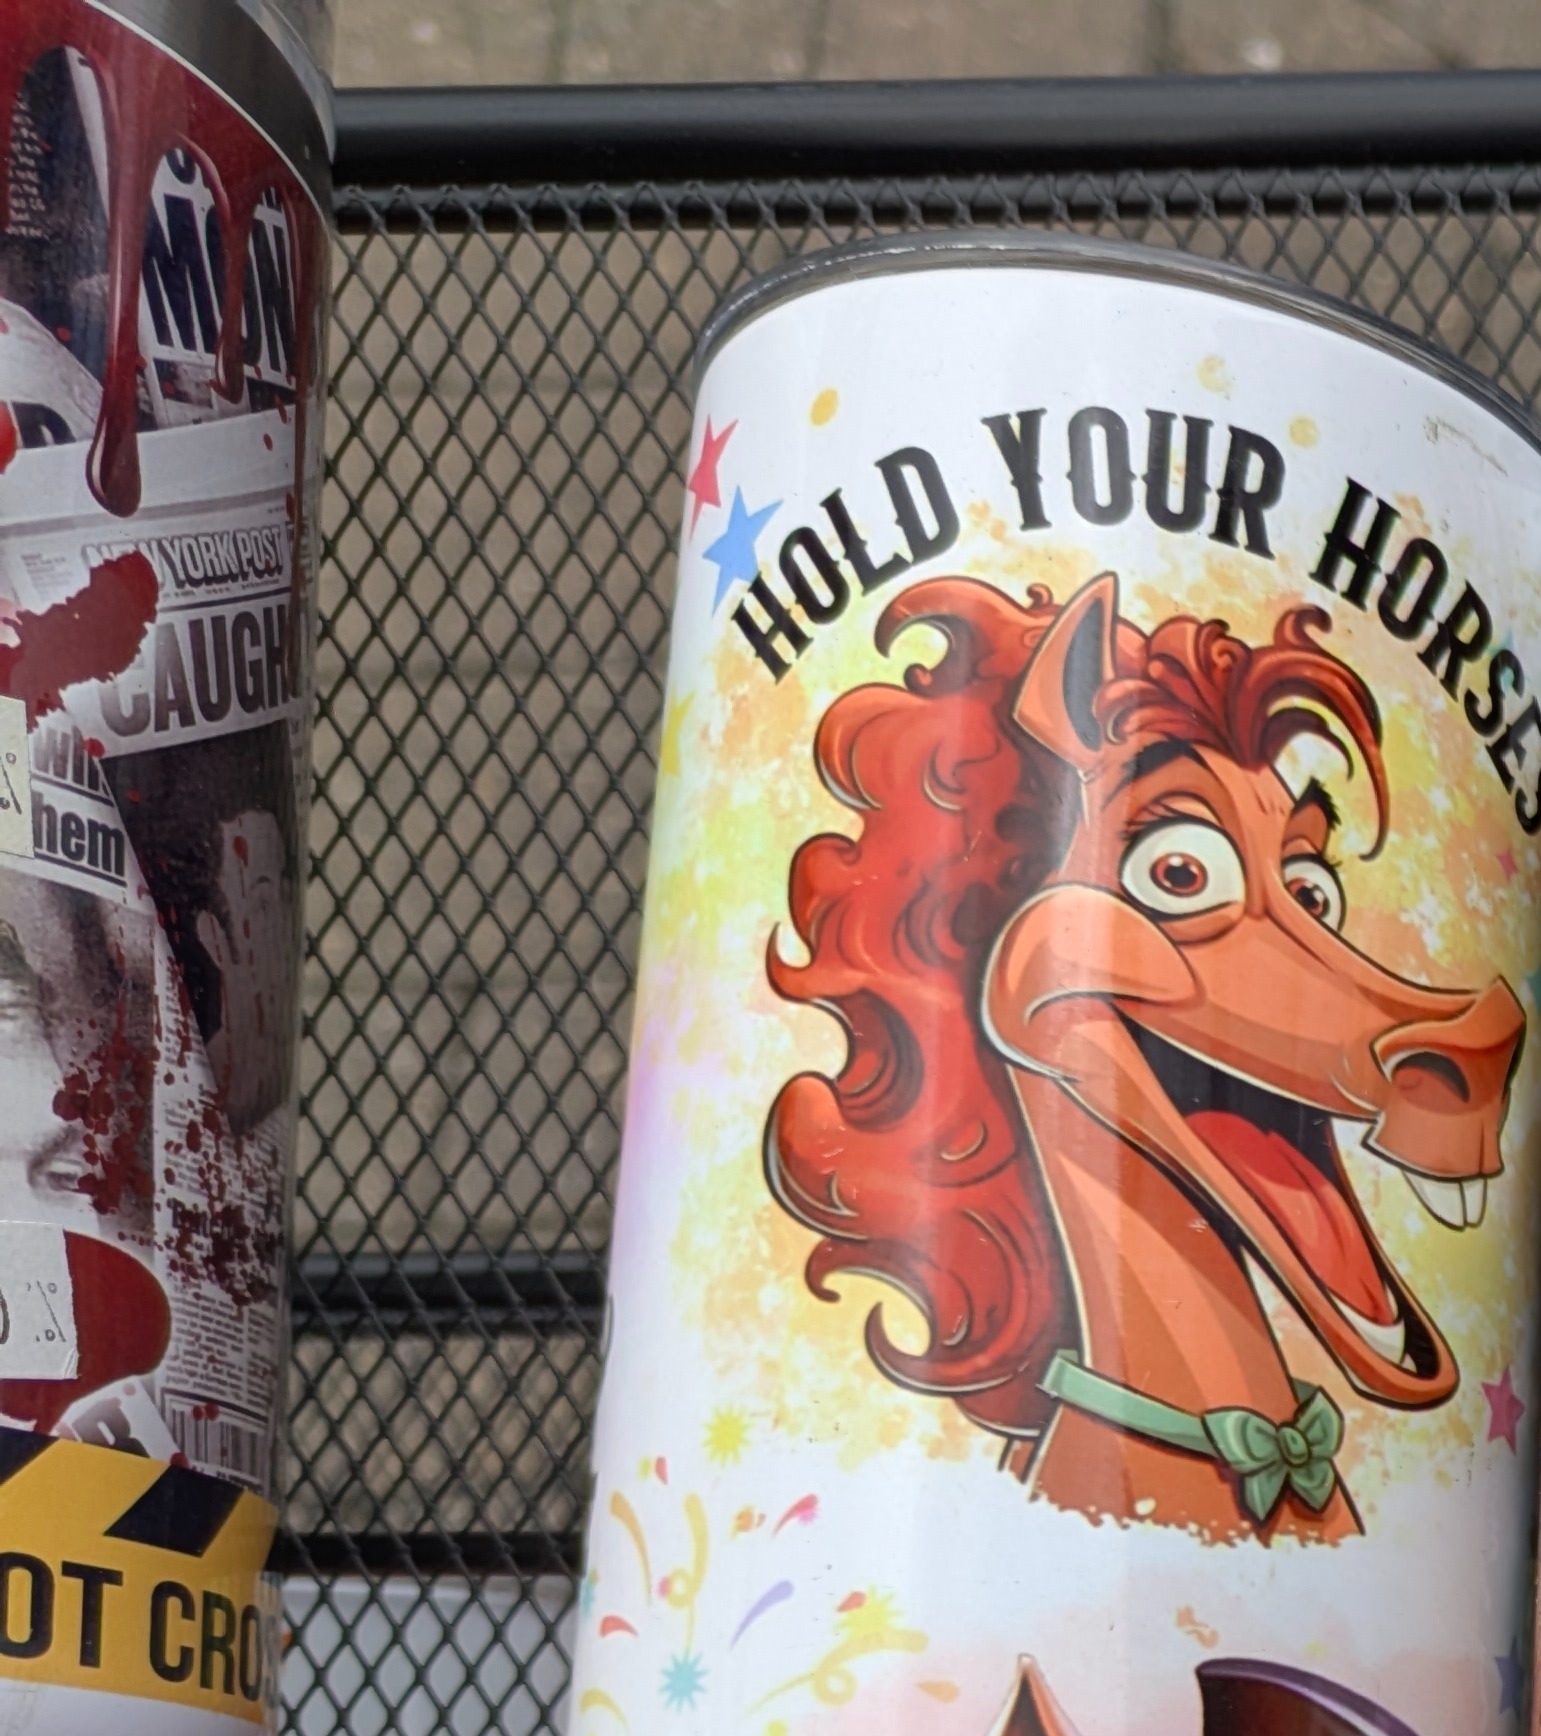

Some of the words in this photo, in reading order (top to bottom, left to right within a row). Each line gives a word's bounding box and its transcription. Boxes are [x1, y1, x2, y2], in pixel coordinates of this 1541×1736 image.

[159, 530, 239, 586] YORK
[235, 525, 285, 580] POST
[730, 445, 961, 684] HOLD
[981, 406, 1285, 559] YOUR
